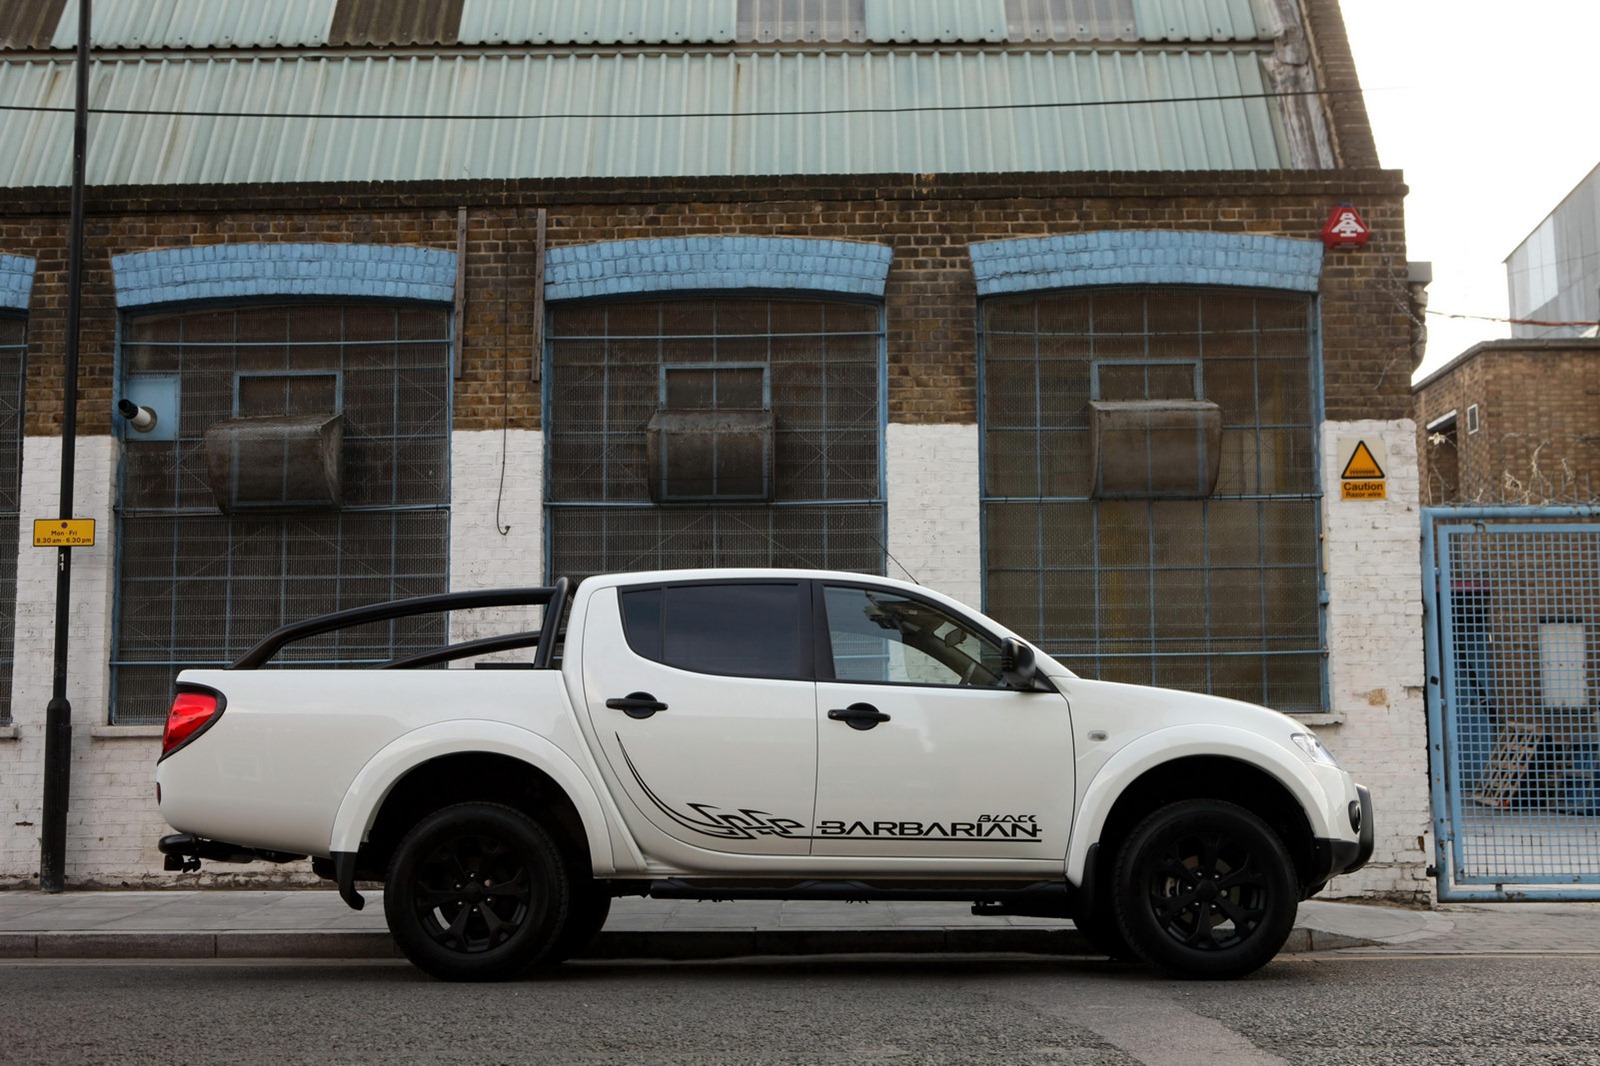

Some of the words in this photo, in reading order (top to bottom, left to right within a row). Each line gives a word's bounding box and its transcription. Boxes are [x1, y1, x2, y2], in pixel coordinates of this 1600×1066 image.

[1344, 482, 1383, 491] Caution
[977, 814, 1037, 823] BLACK
[816, 820, 1042, 838] BARBARIAN
